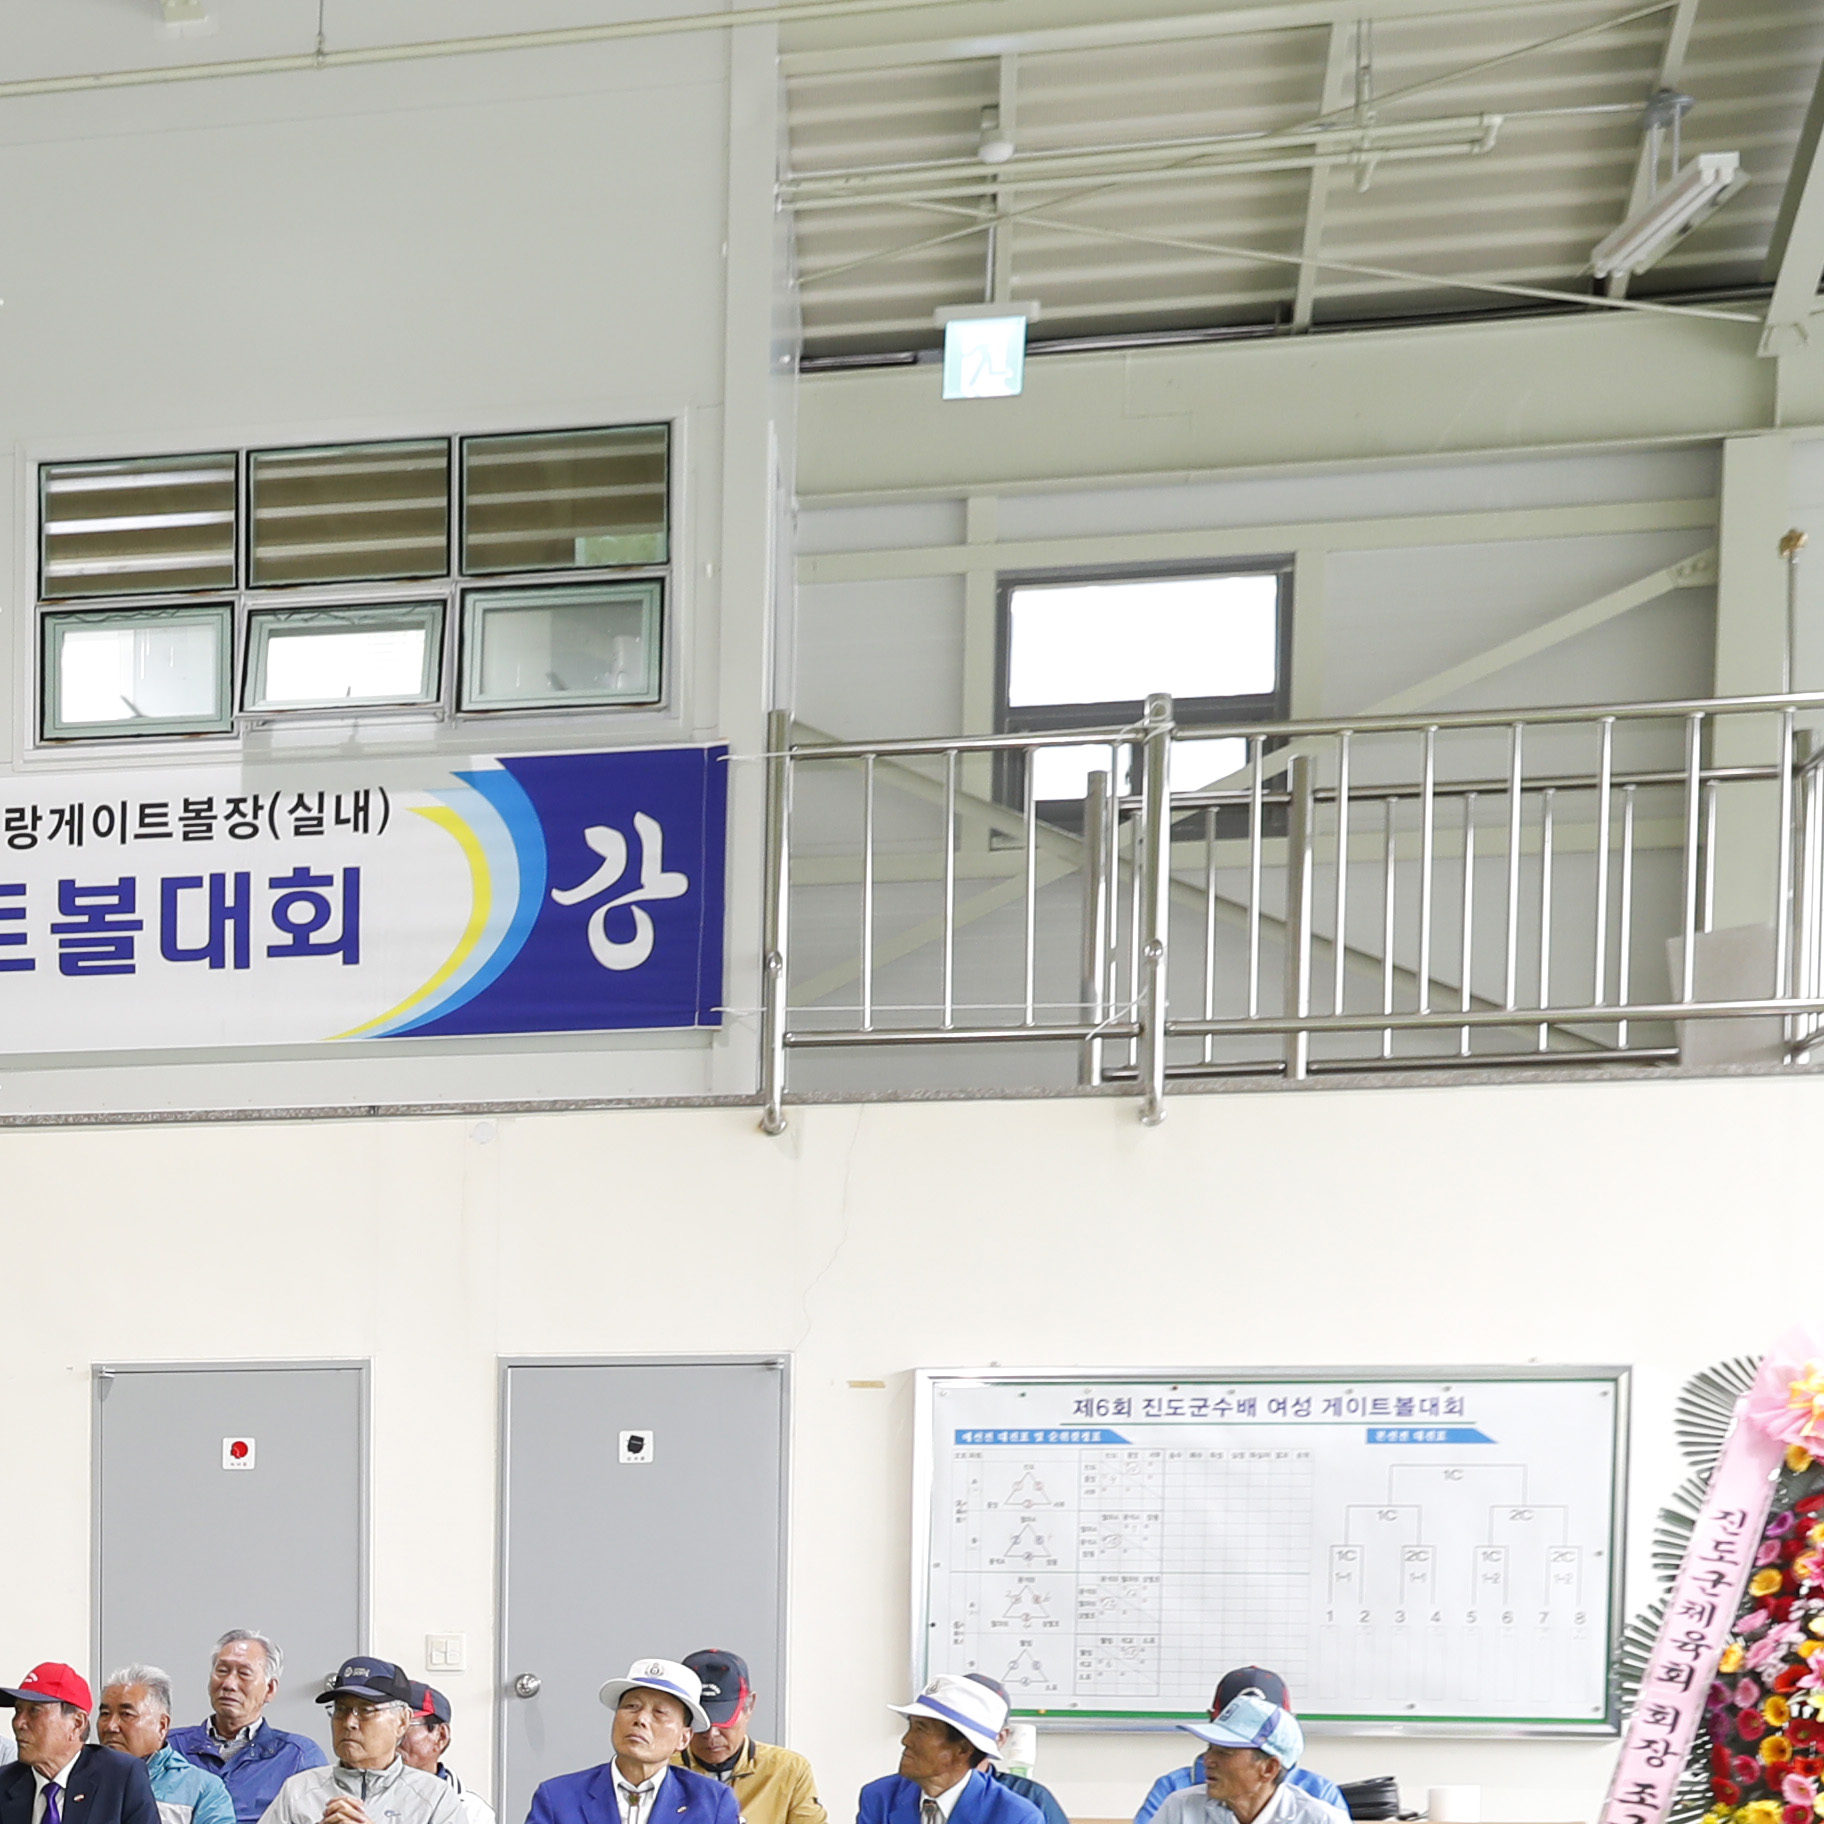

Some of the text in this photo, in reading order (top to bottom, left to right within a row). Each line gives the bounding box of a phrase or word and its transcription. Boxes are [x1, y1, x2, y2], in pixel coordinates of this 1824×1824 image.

[551, 812, 688, 970] 강
[1073, 1396, 1465, 1417] 제6회 진도군수배 여성 게이트볼대회
[1442, 1469, 1464, 1481] 1C
[1377, 1510, 1398, 1521] 1C
[1509, 1510, 1534, 1521] 2C
[1656, 1508, 1748, 1692] 진도군체육회
[1326, 1611, 1333, 1622] 1
[1360, 1611, 1370, 1622] 2
[1395, 1611, 1406, 1622] 3
[1430, 1612, 1441, 1622] 4
[1466, 1612, 1478, 1623] 5
[1502, 1612, 1513, 1623] 6
[1538, 1612, 1550, 1624] 7
[1574, 1612, 1586, 1624] 8
[1634, 1703, 1680, 1770] 회장
